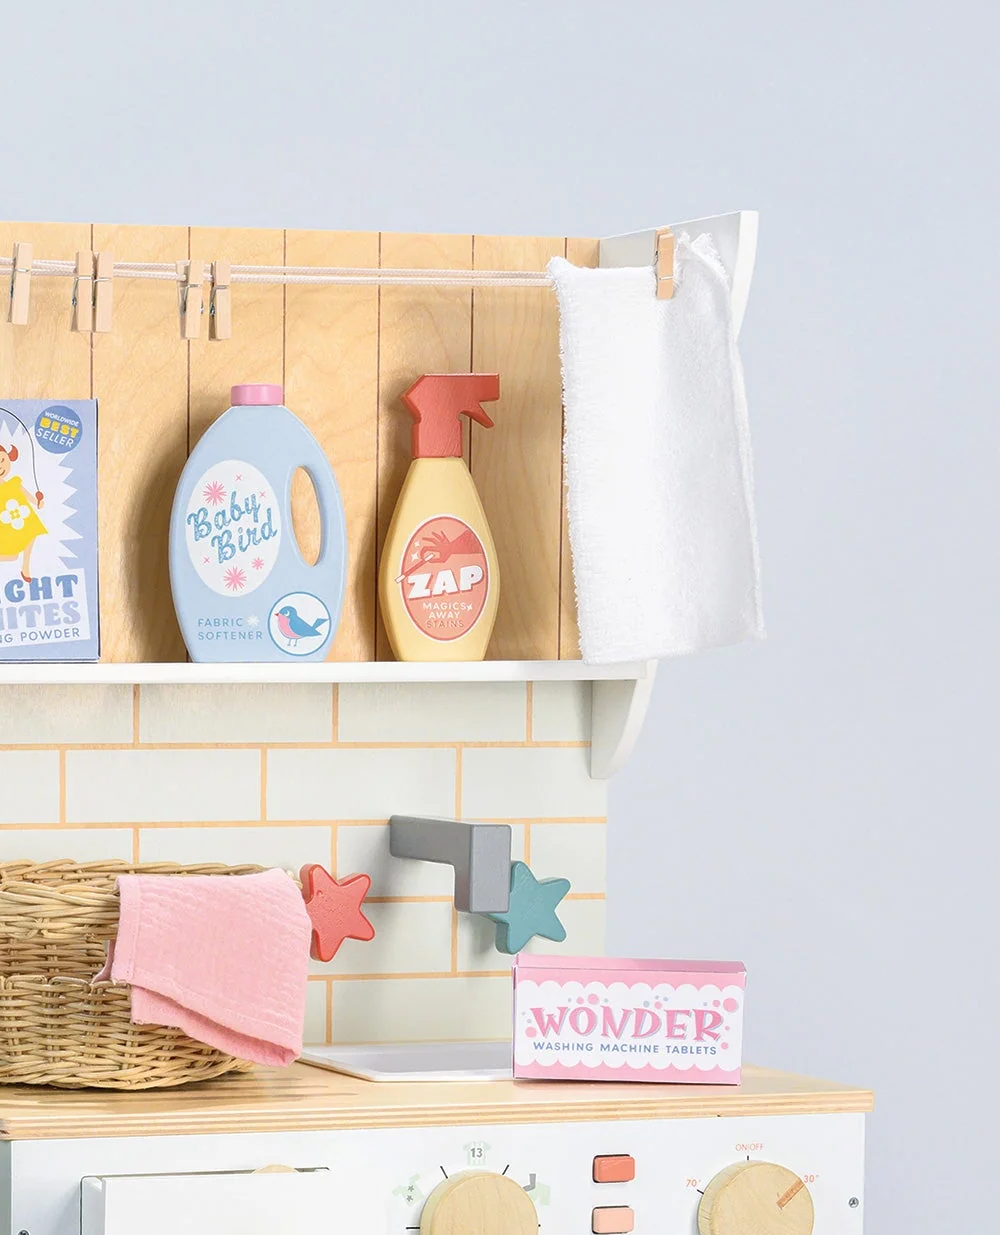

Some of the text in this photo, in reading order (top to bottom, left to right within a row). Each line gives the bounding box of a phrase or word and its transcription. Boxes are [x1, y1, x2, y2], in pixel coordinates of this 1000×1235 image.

[45, 411, 79, 427] WORLDWIDE
[40, 417, 79, 438] BEST
[36, 428, 74, 447] SELLER
[187, 490, 261, 542] Baby
[211, 508, 278, 564] Bird
[407, 565, 484, 600] ZAP
[198, 617, 244, 628] FABRIC
[429, 611, 461, 619] AWAY
[426, 620, 464, 628] STAINS
[20, 627, 81, 642] POWDER
[198, 630, 263, 641] SOFTENER
[530, 1005, 725, 1042] WONDER
[533, 1041, 717, 1055] WASHING MACHINE TABLETS
[470, 1147, 483, 1158] 13
